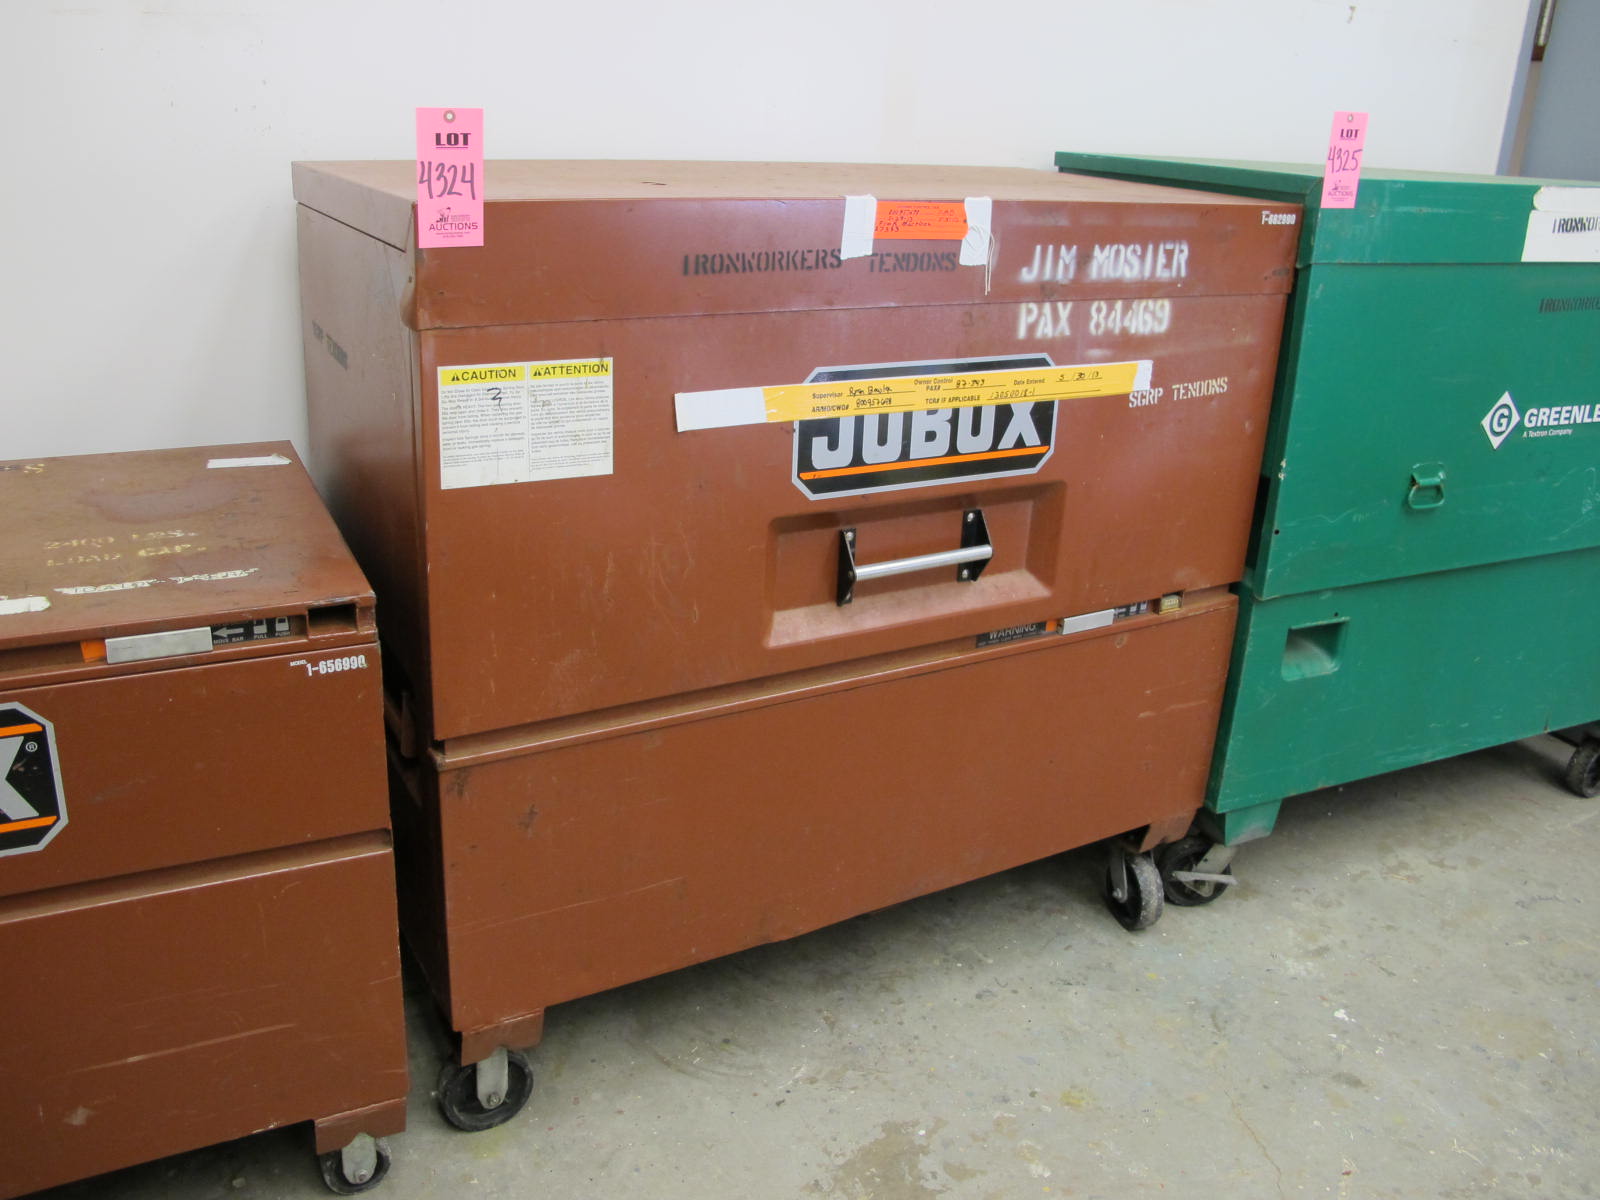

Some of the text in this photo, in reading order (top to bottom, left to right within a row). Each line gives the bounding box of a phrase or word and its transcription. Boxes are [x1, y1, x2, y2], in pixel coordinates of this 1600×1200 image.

[435, 133, 471, 146] LOT
[1340, 128, 1359, 139] LOT
[1328, 146, 1363, 174] 4325
[419, 161, 475, 200] 4324
[429, 222, 479, 231] AUCTIONS
[682, 248, 958, 277] IRONWORKERS TENDONS
[1019, 240, 1189, 284] JIM MOSIER
[1017, 299, 1171, 340] PAX 84469
[461, 368, 517, 382] CAUTION
[543, 363, 609, 376] ATTENTION
[811, 392, 843, 400] Supervisor
[1172, 377, 1229, 401] TENDONS
[1492, 407, 1510, 433] G
[1528, 430, 1548, 438] Textron
[1548, 428, 1573, 437] Company
